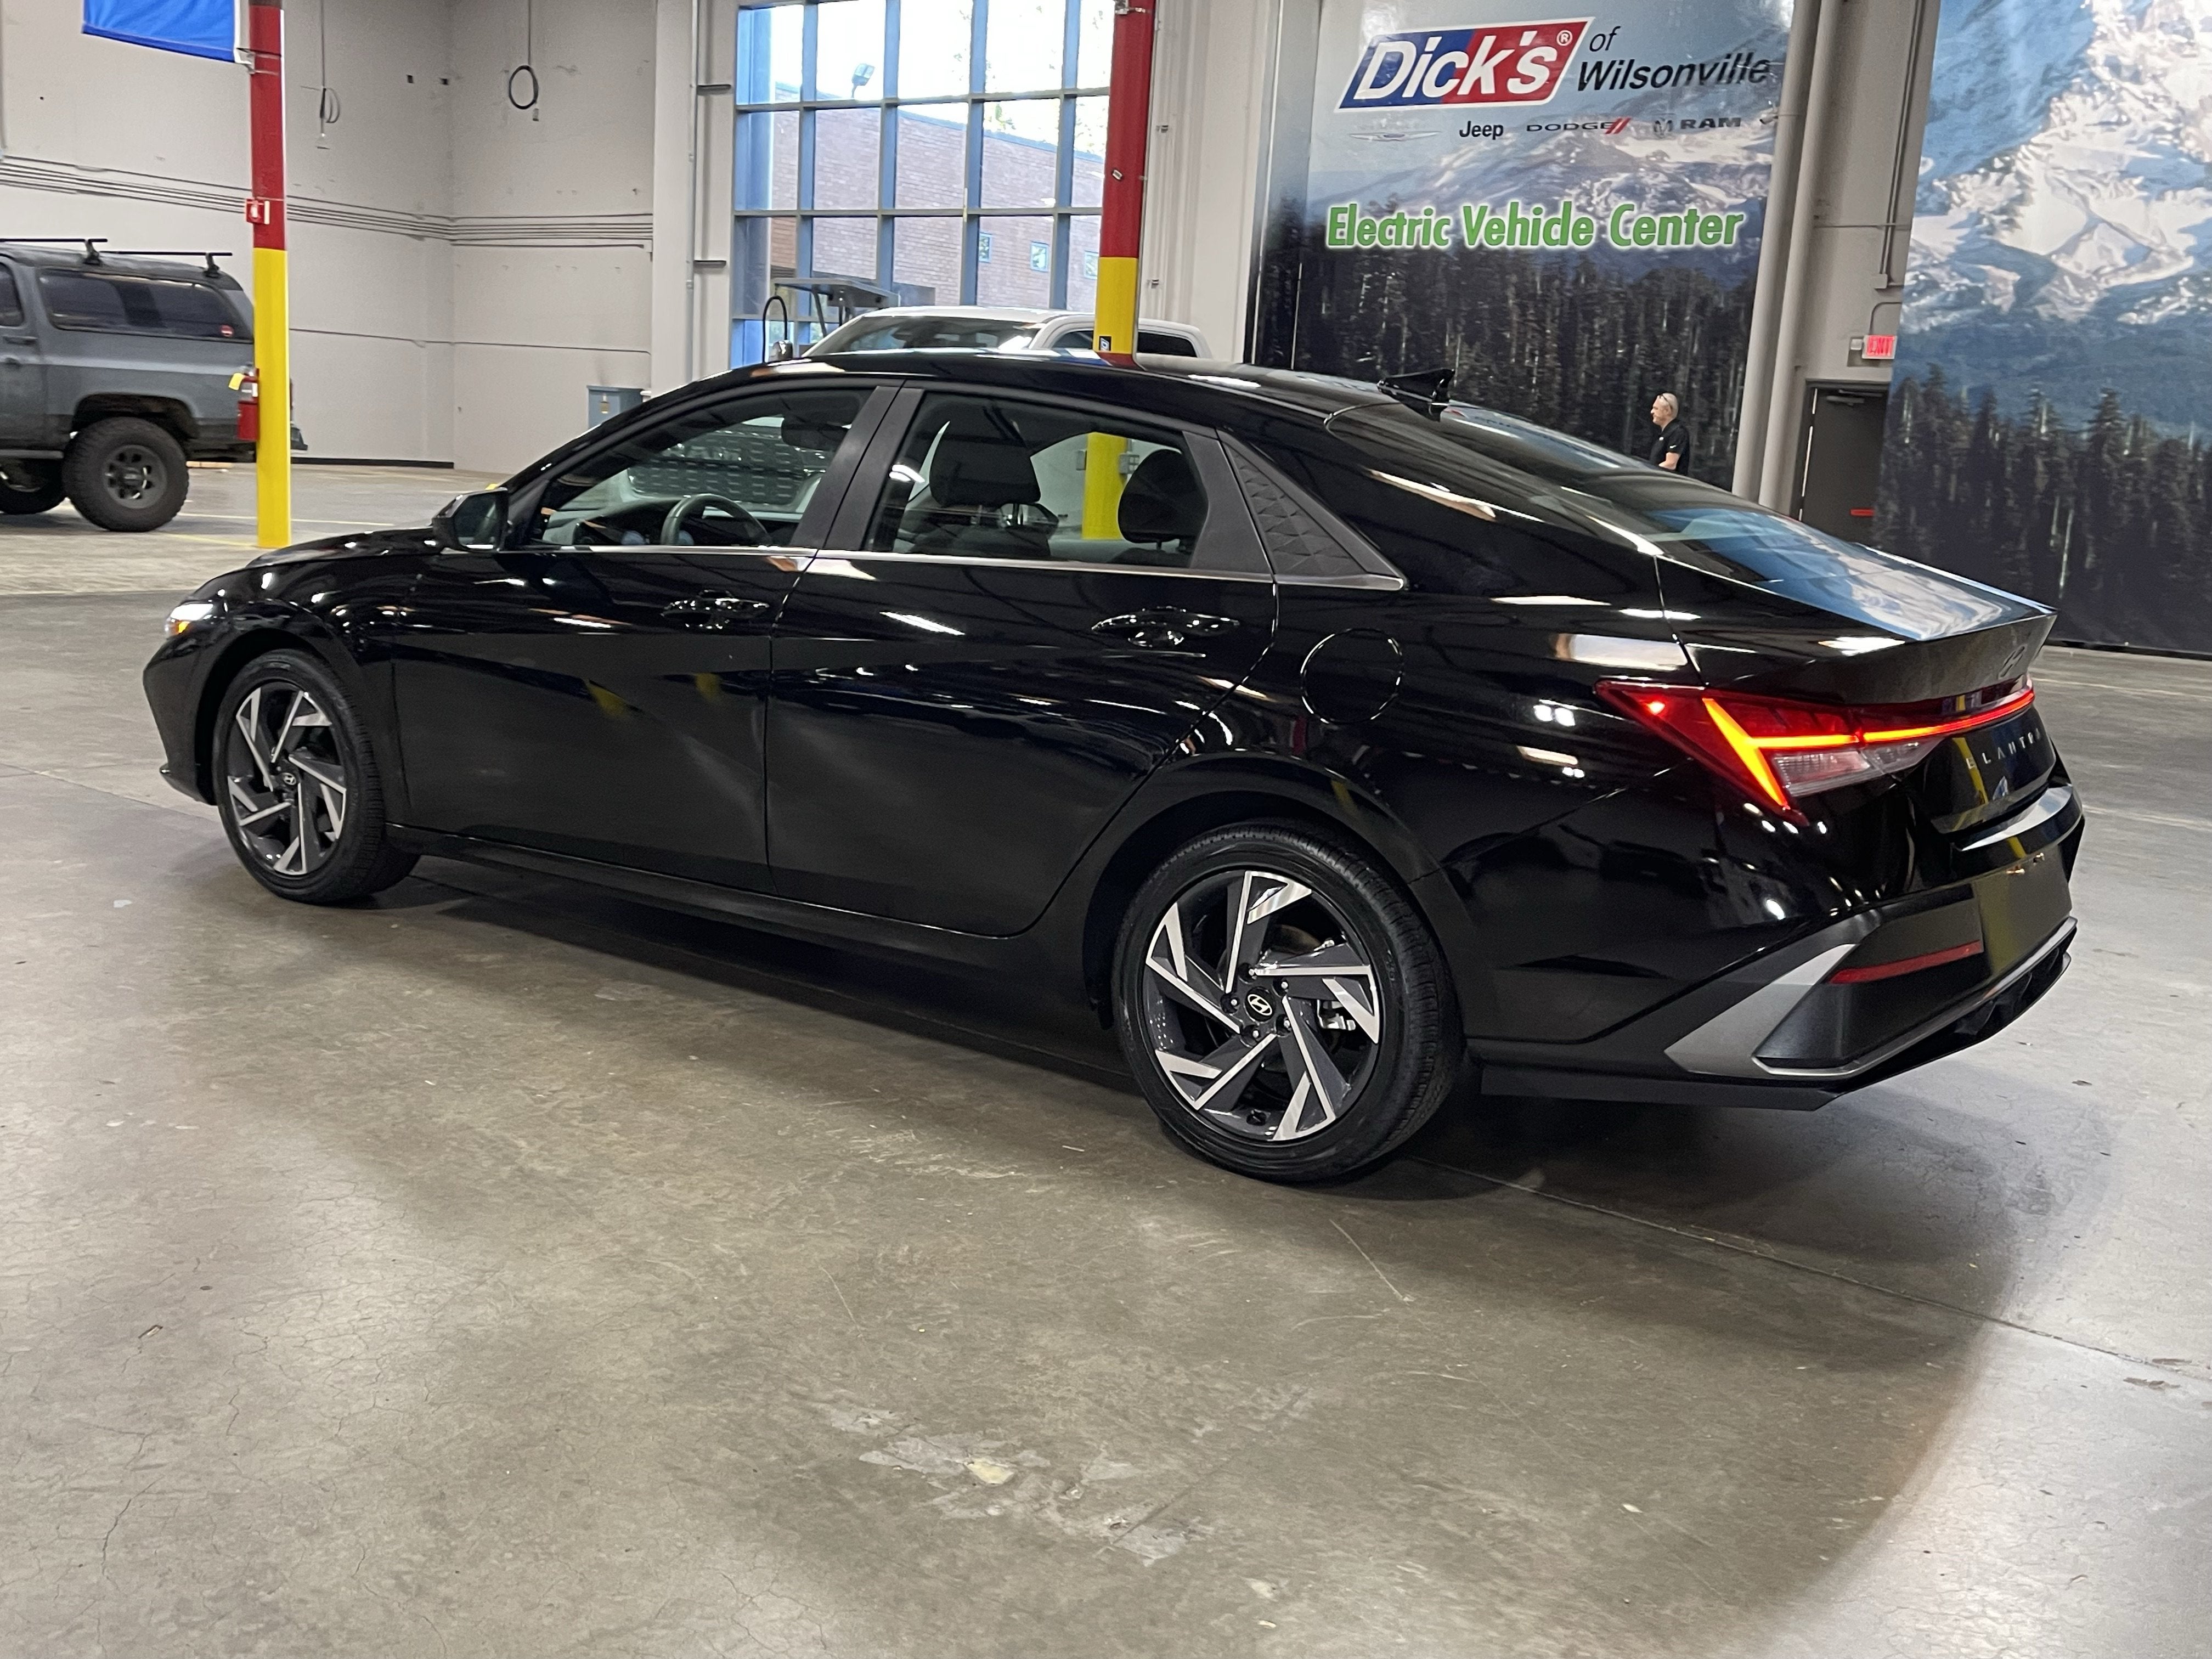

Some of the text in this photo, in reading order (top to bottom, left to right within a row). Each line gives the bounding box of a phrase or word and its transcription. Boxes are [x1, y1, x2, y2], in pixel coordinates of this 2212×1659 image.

[1353, 26, 1621, 100] Dick's of
[1577, 52, 1771, 91] Wilsonville
[1459, 117, 1741, 140] Jeep DODGE RAM
[1328, 201, 1744, 246] Electric Vehicle Center
[1867, 335, 1895, 357] EXIT
